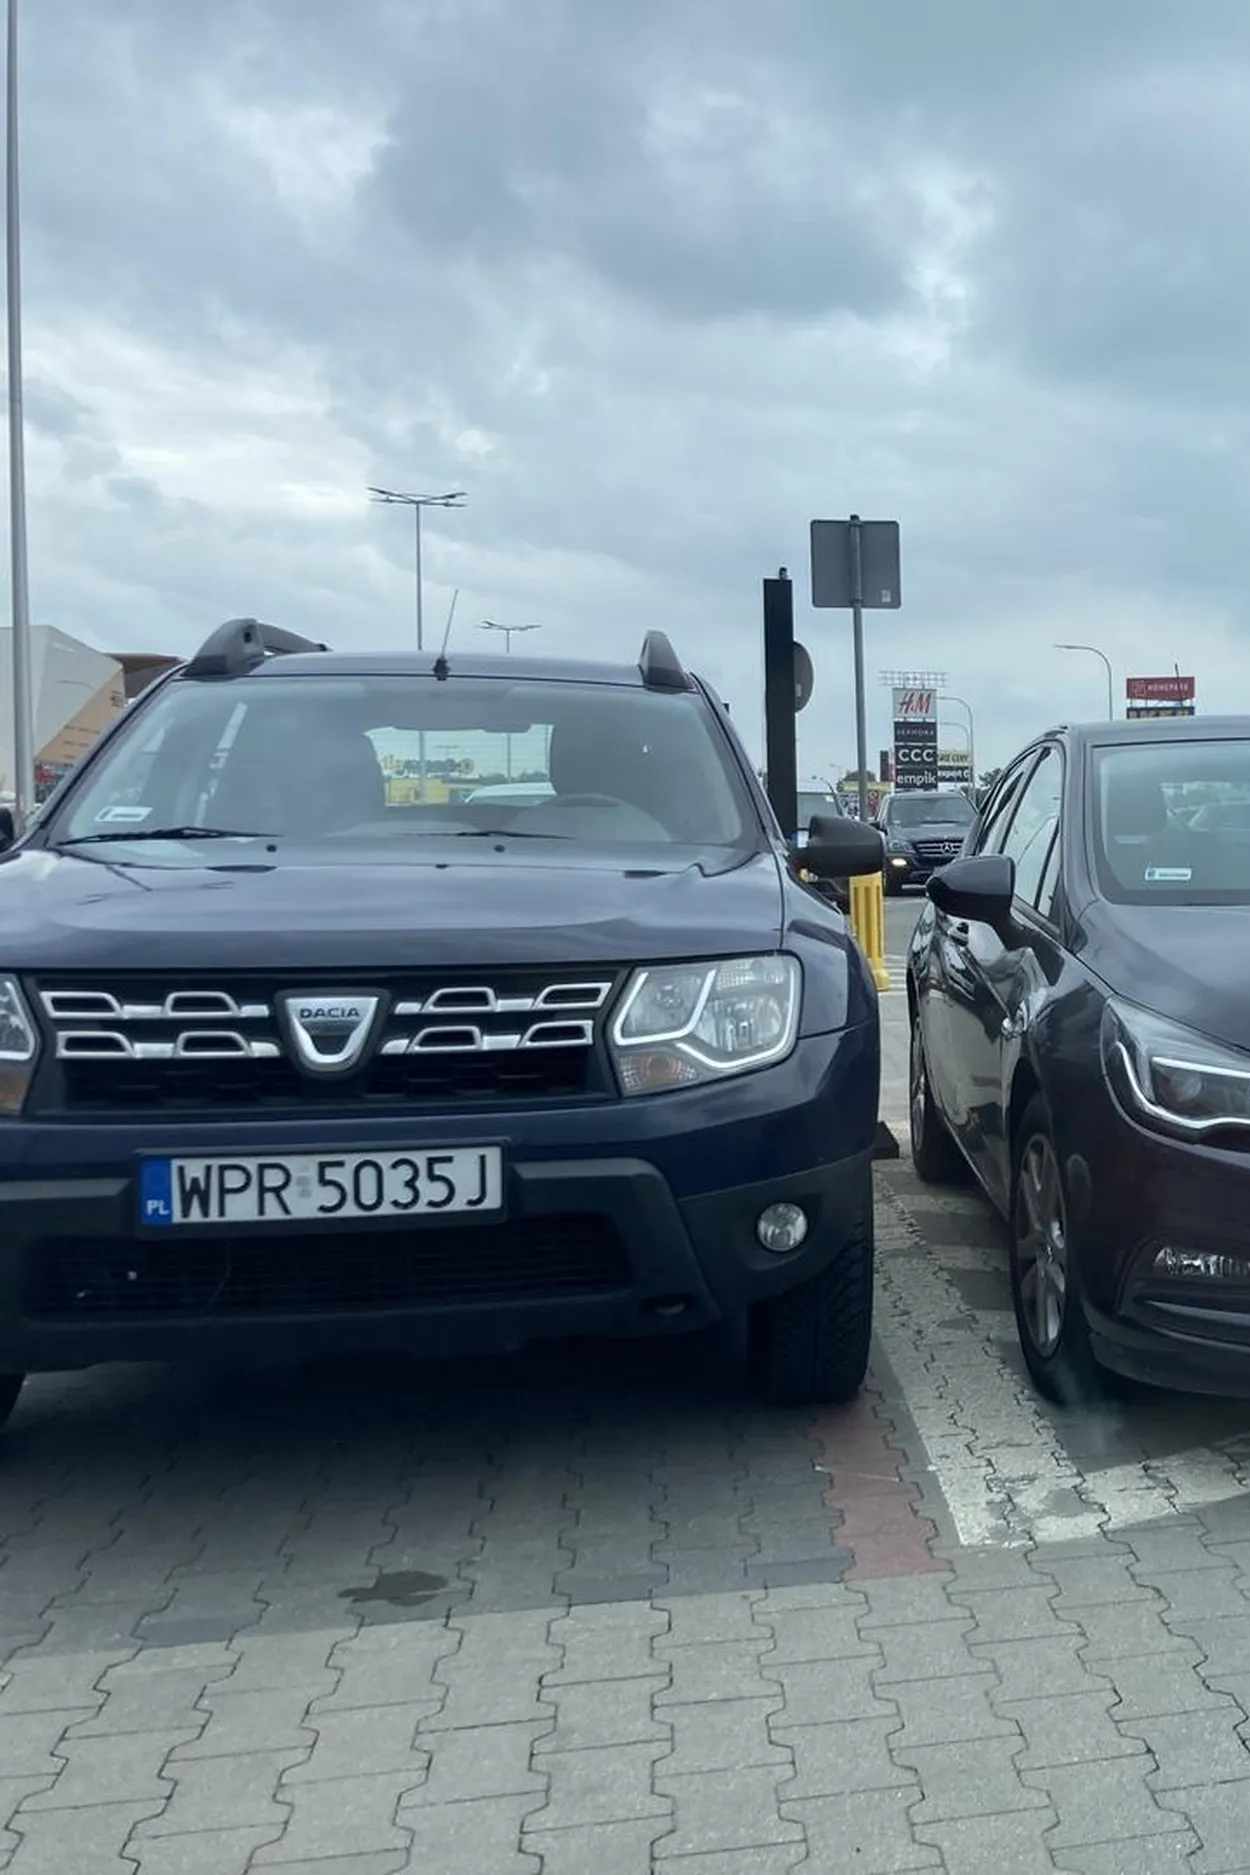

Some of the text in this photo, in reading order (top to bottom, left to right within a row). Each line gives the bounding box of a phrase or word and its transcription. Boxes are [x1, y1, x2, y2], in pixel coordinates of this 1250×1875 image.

[898, 749, 934, 762] CCC
[896, 770, 937, 786] empik
[300, 1007, 360, 1018] DACIA
[178, 1154, 488, 1219] WPR 5035J
[147, 1200, 170, 1215] PL
